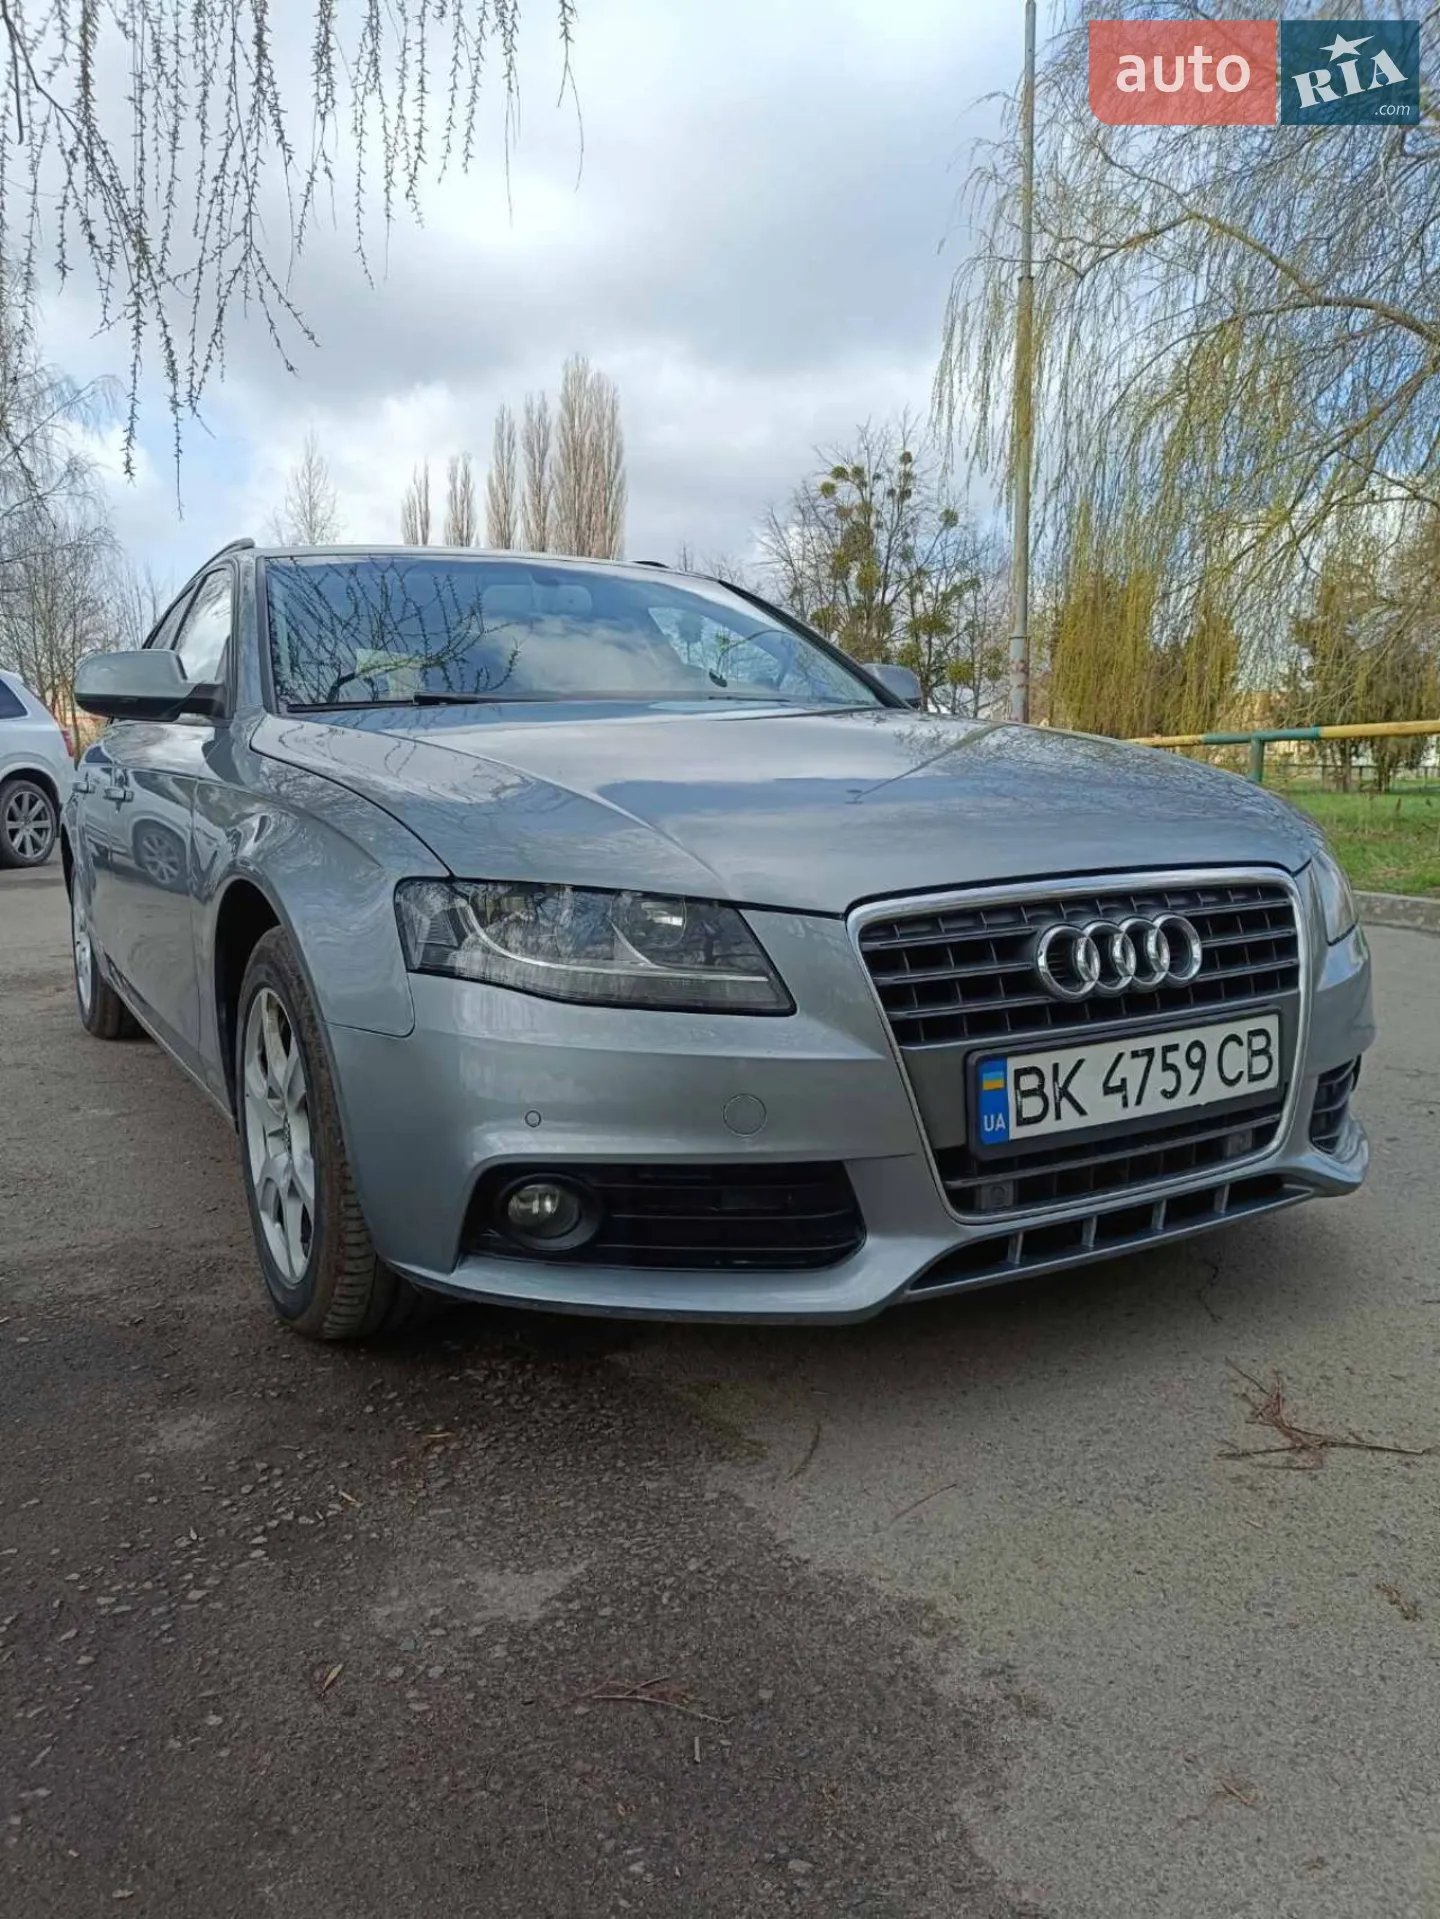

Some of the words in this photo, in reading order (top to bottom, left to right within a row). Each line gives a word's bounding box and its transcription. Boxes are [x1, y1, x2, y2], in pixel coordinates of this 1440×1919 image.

[1013, 1058, 1088, 1128] BK
[1102, 1039, 1207, 1109] 4759
[1217, 1027, 1274, 1088] CB
[983, 1112, 1006, 1132] UA
